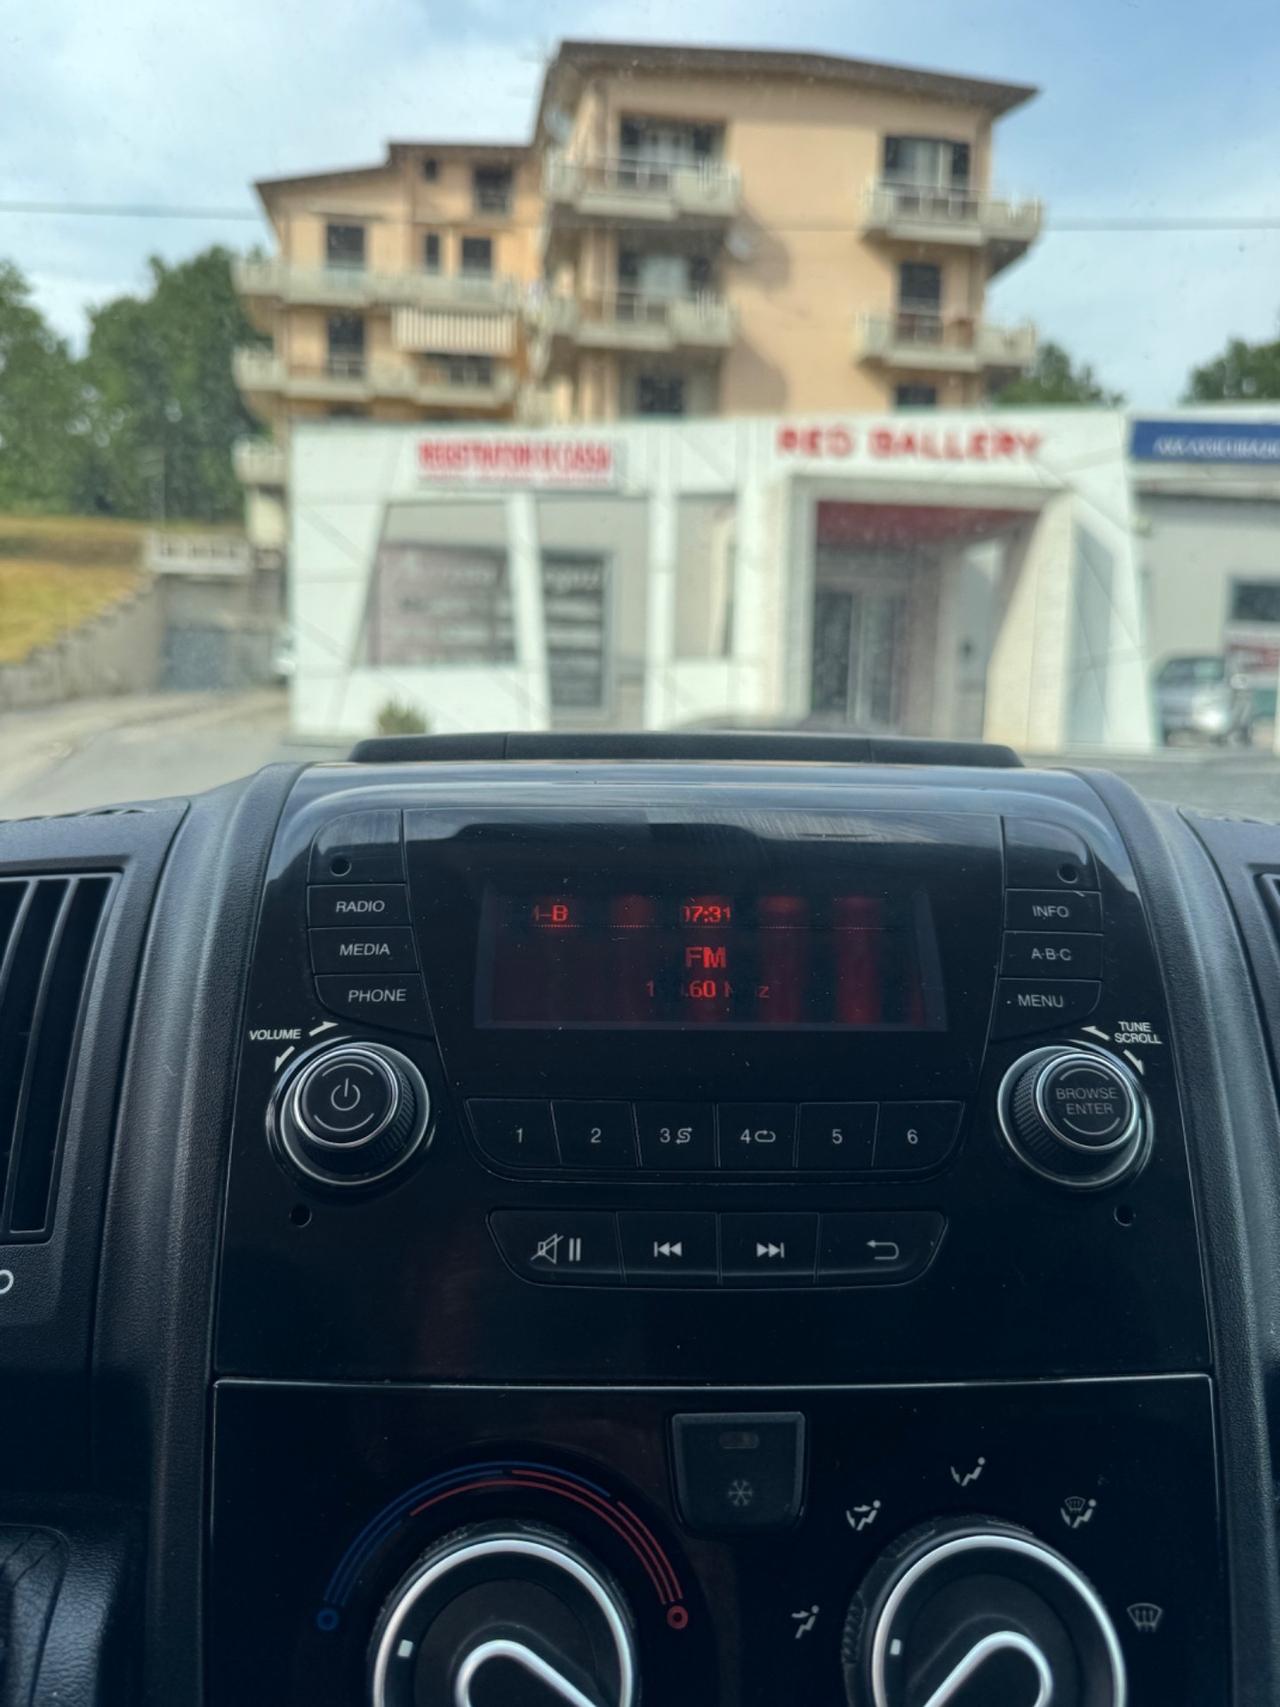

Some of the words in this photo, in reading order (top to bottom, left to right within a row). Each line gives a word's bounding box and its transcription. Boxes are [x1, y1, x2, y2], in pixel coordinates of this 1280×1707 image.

[335, 900, 385, 912] RADIO
[1032, 905, 1069, 918] INFO
[339, 943, 391, 956] MEDIA
[685, 946, 727, 969] FM
[348, 989, 407, 1003] PHONE
[1018, 994, 1064, 1008] MENU
[1118, 1021, 1151, 1033] TUNE
[249, 1029, 302, 1041] VOLUME
[1114, 1033, 1162, 1045] SCROLL
[1055, 1087, 1118, 1100] BROWSE
[1066, 1102, 1114, 1116] ENTER
[515, 1128, 524, 1144] 1
[590, 1128, 602, 1144] 2
[659, 1128, 671, 1144] 3
[740, 1128, 752, 1144] 4
[832, 1128, 843, 1144] 5
[906, 1128, 918, 1144] 6
